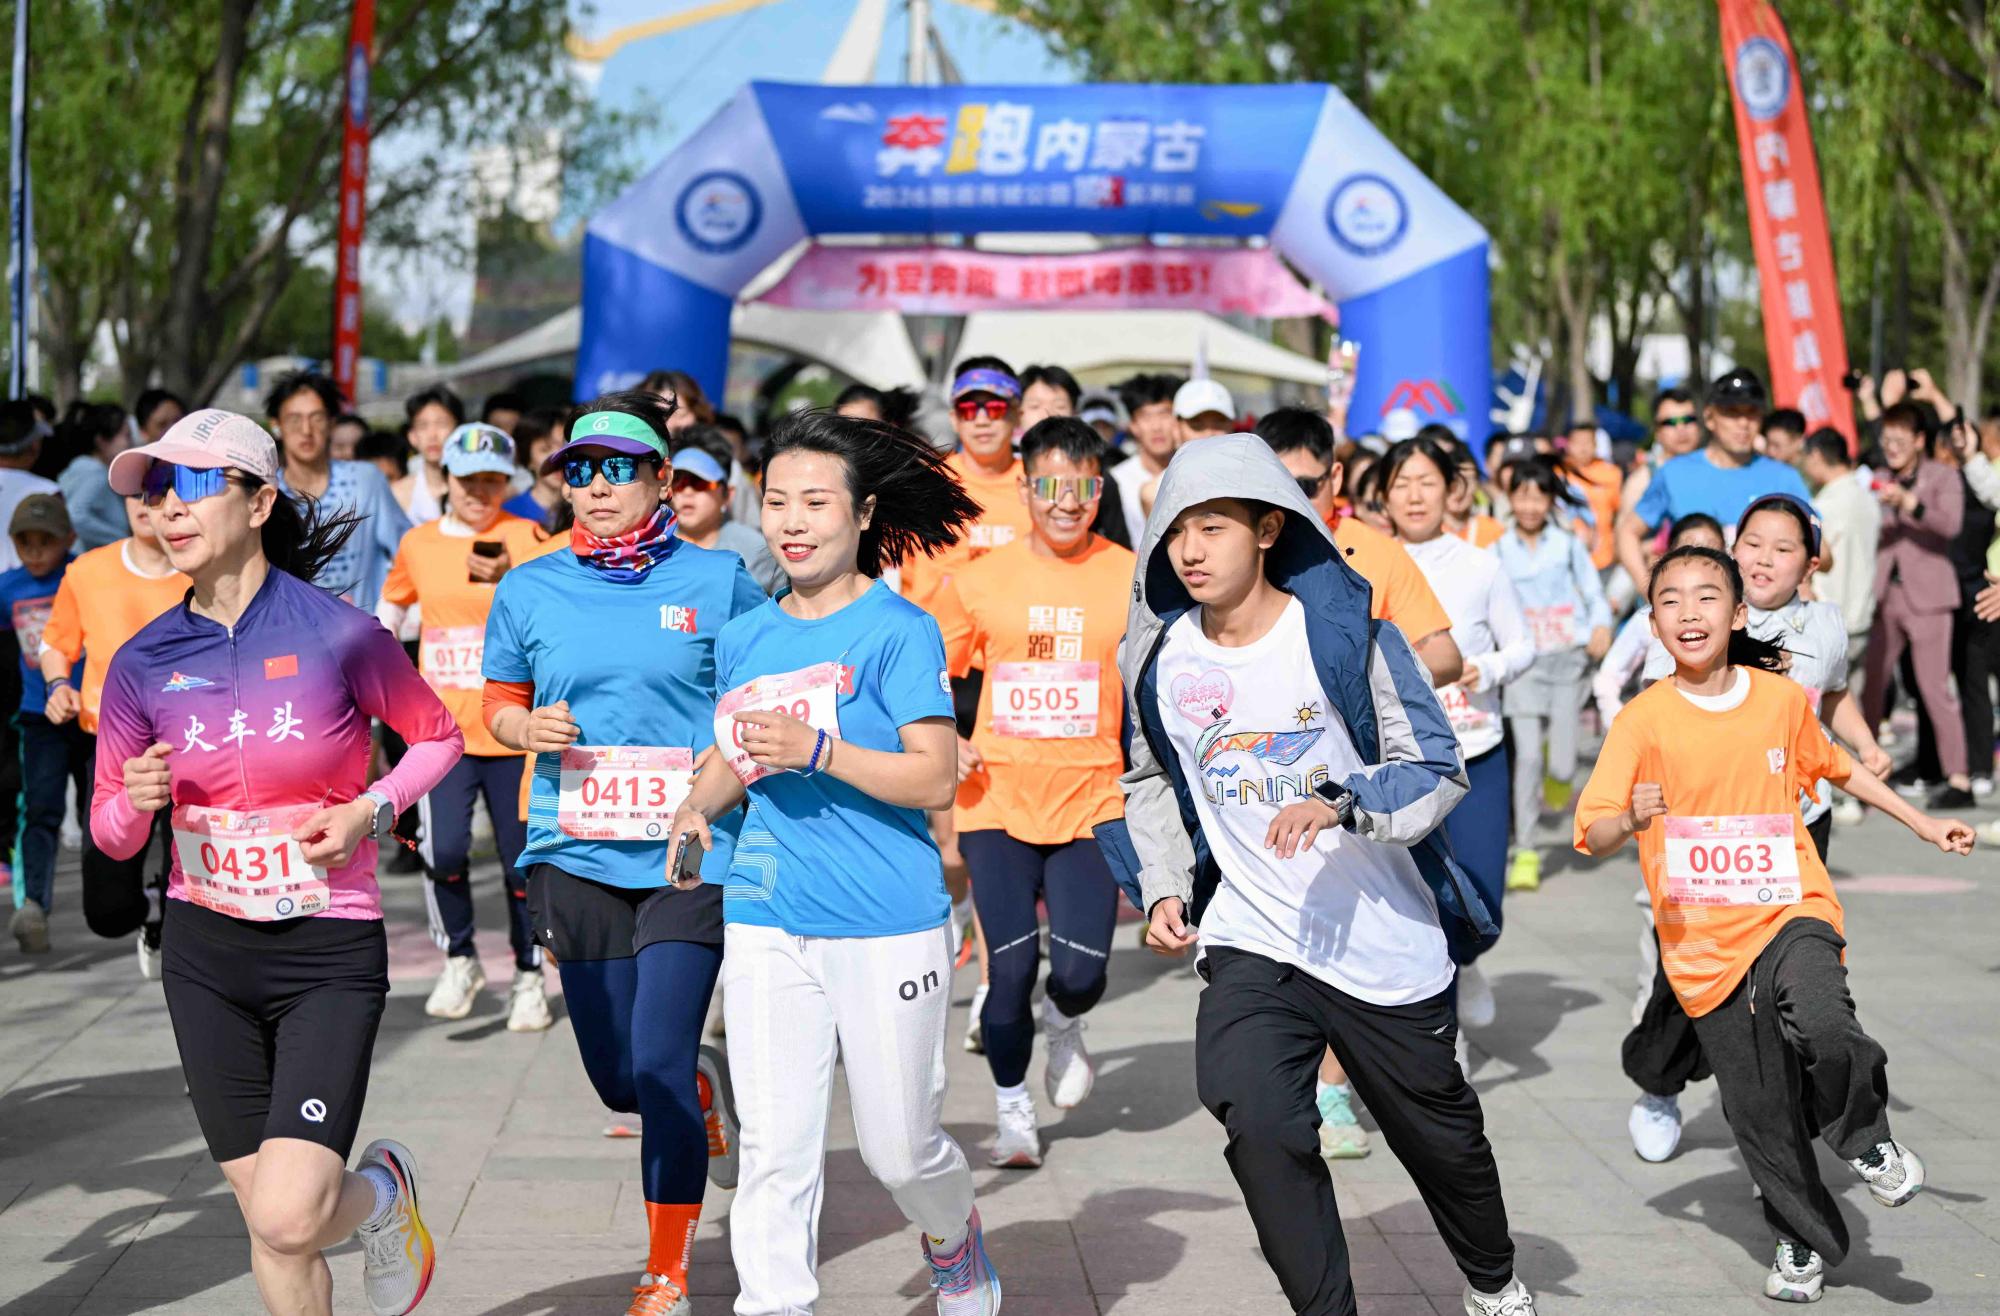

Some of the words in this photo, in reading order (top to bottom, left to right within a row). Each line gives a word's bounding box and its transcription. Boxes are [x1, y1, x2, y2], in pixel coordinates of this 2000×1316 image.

[875, 101, 1206, 177] 奔跑内蒙古
[1028, 606, 1084, 633] 黑暗
[1028, 634, 1082, 662] 跑团
[1010, 687, 1079, 711] 0505
[181, 701, 305, 754] 火车头
[582, 776, 667, 807] 0413
[200, 842, 291, 881] 0431
[1689, 844, 1773, 874] 0063
[899, 970, 939, 1001] on
